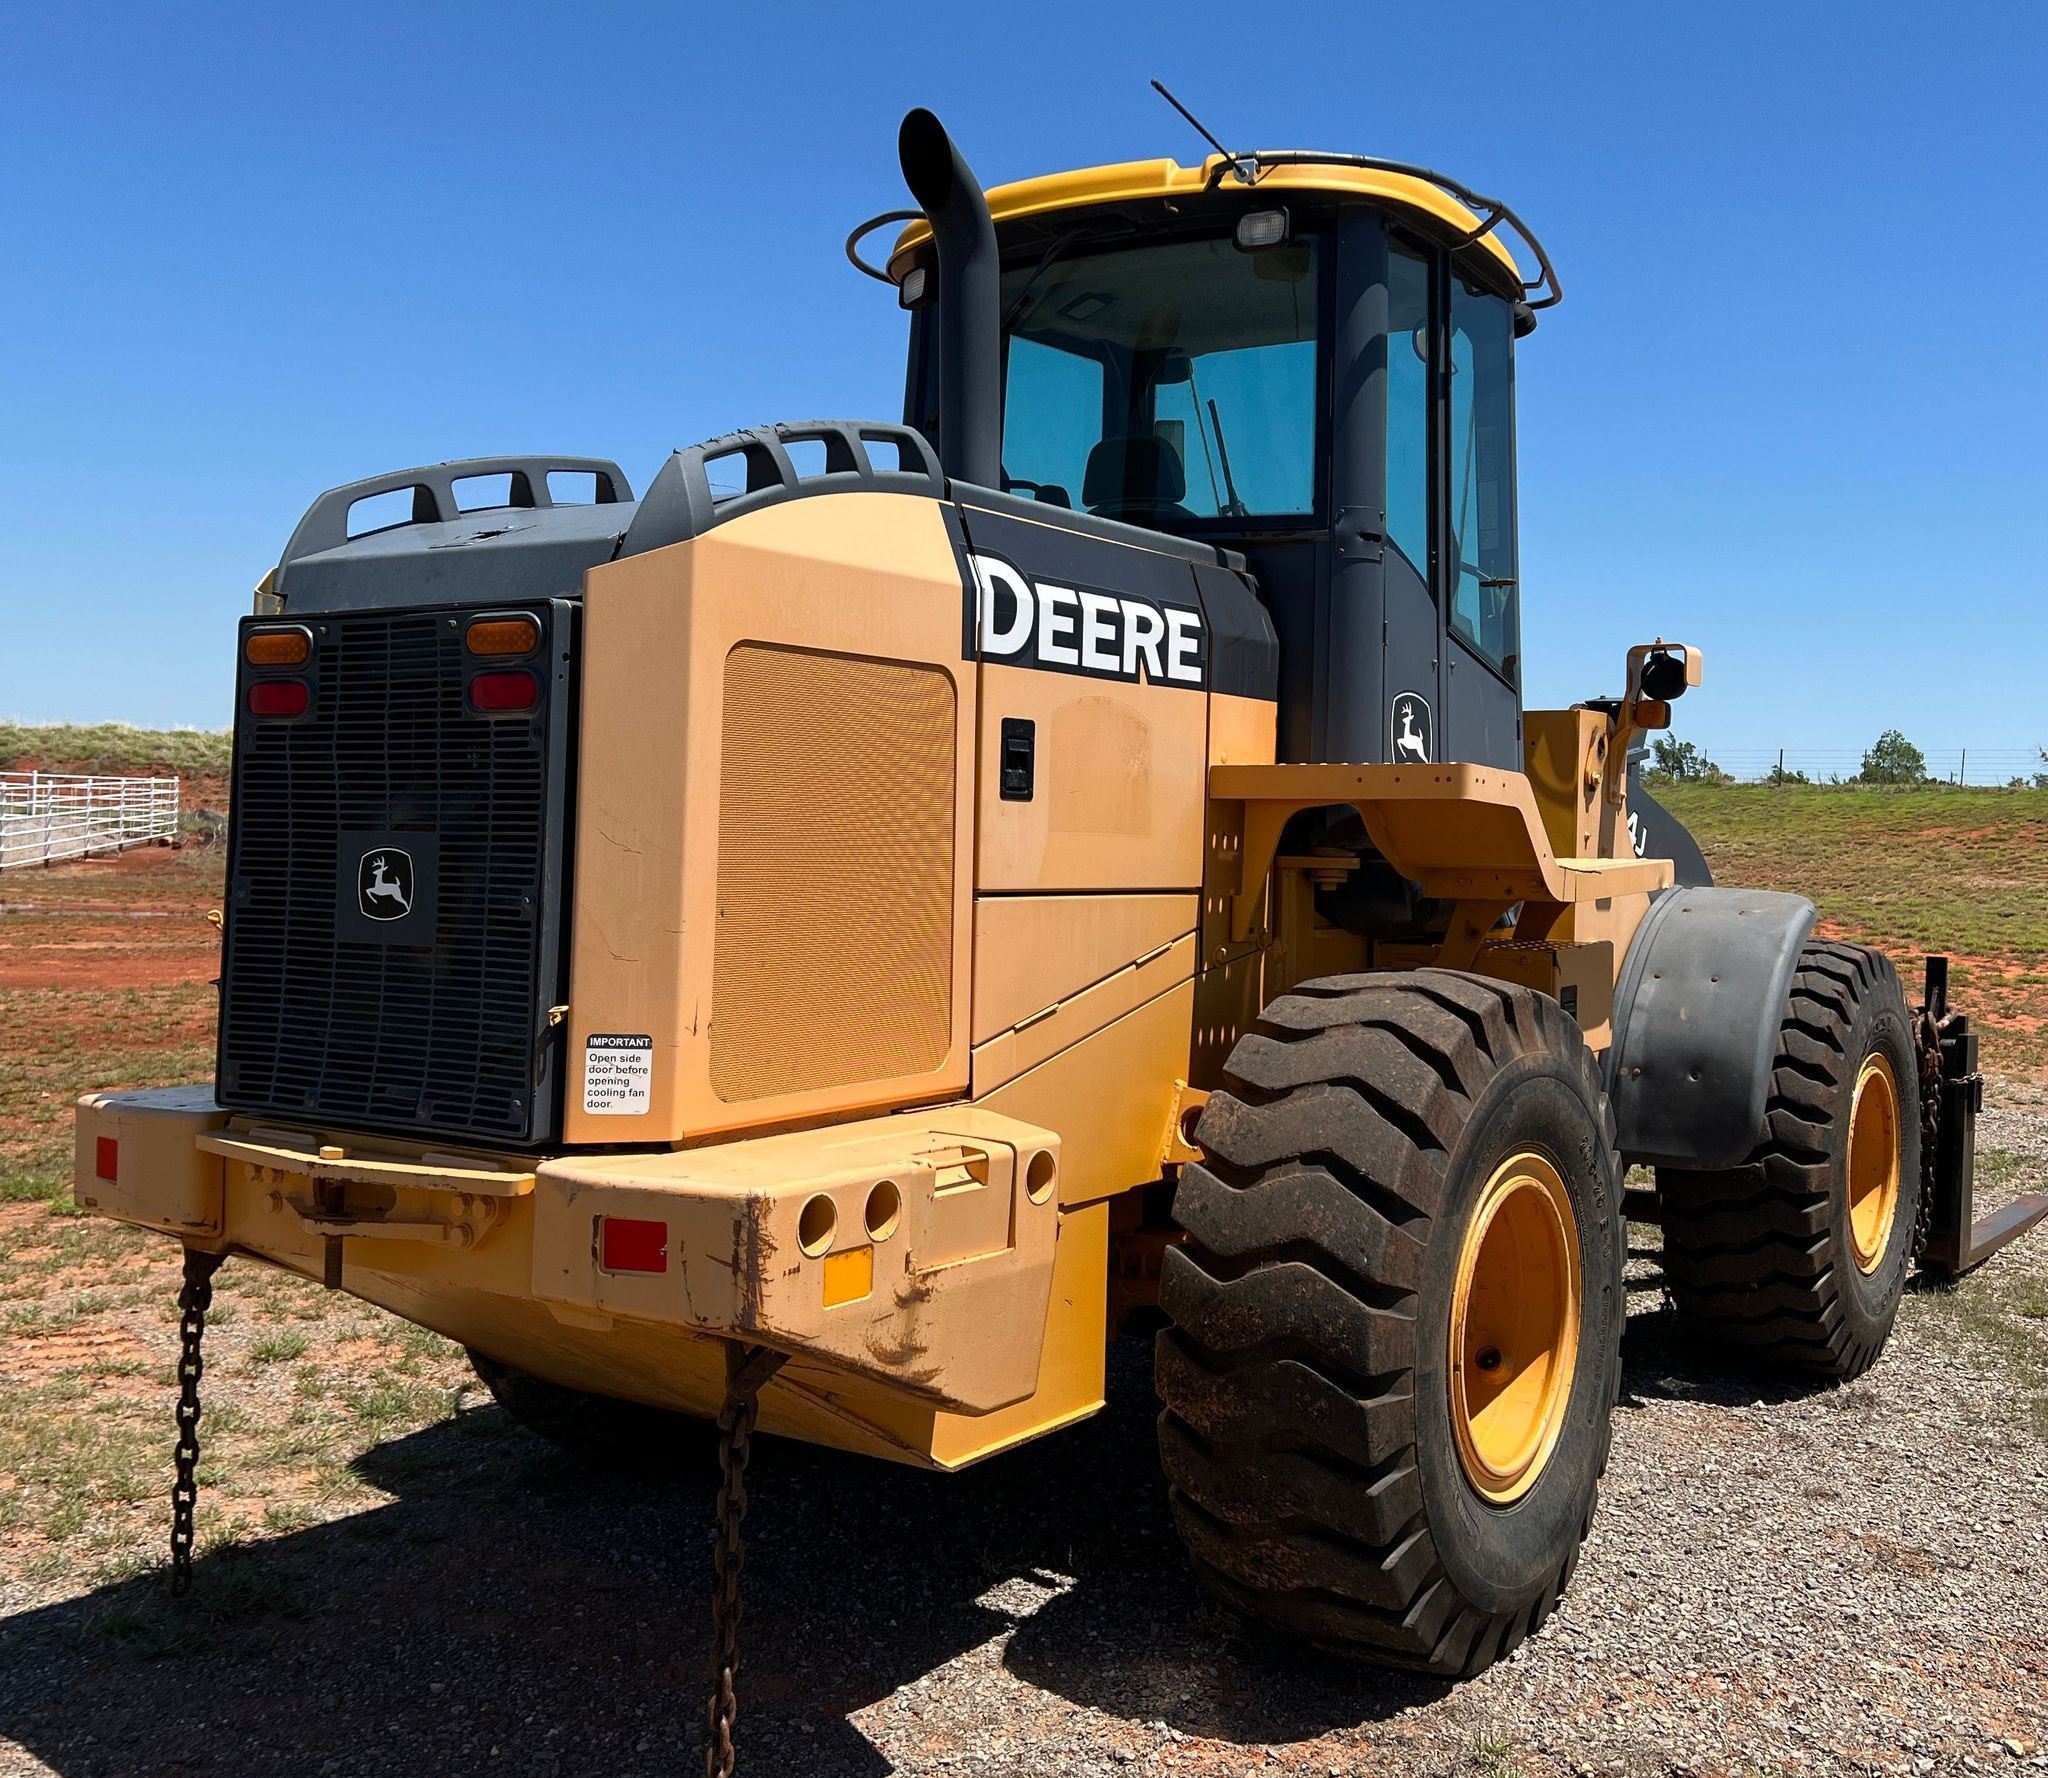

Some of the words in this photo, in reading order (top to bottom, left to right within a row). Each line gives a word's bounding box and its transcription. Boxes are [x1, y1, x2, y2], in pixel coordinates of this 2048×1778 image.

[966, 553, 1202, 683] DEERE
[590, 1037, 650, 1047] IMPORTANT
[589, 1053, 616, 1063] Open
[620, 1054, 641, 1062] side
[588, 1065, 613, 1074] door
[616, 1065, 648, 1074] before
[588, 1077, 630, 1087] opening
[587, 1088, 626, 1099] cooling
[629, 1088, 645, 1098] fan
[586, 1100, 613, 1109] door.
